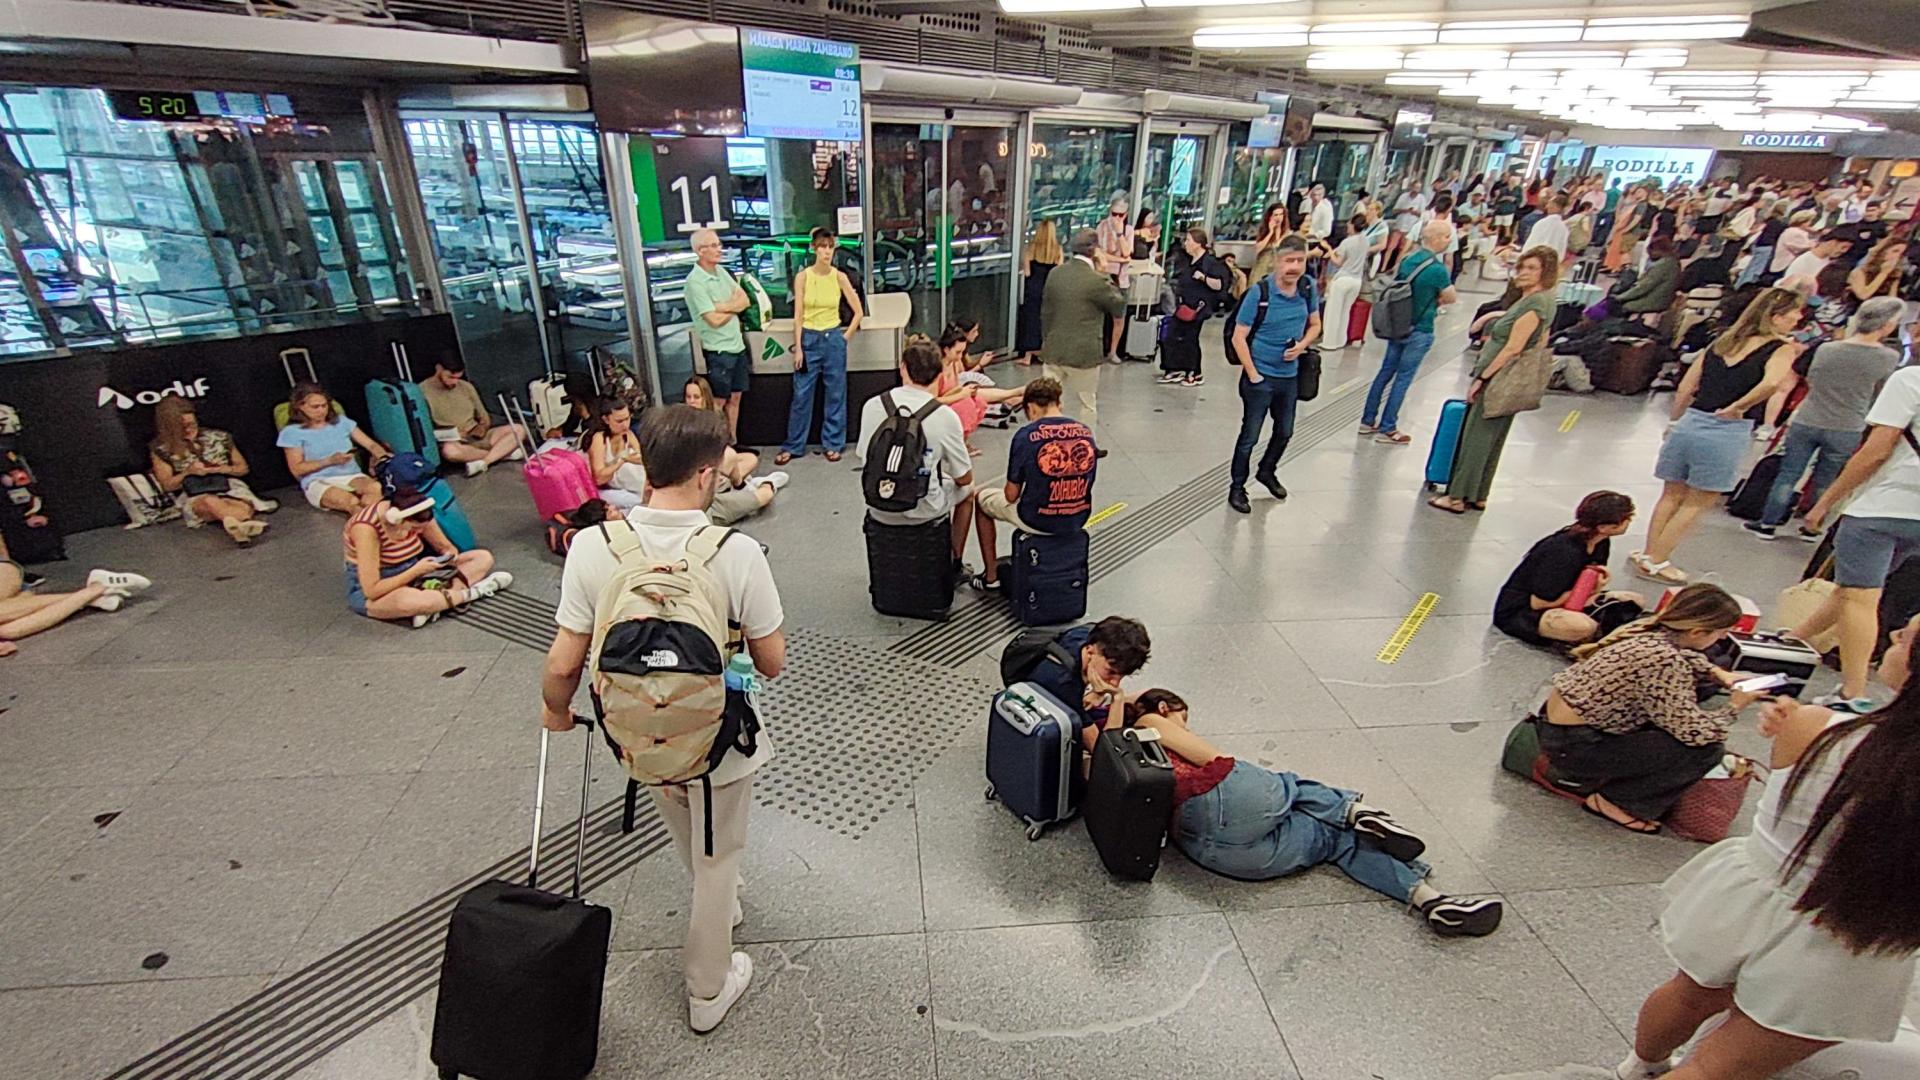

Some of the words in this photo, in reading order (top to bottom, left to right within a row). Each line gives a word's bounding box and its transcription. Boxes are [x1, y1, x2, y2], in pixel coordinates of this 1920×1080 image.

[812, 42, 853, 59] ZAMBRANO
[842, 98, 858, 117] 12
[1741, 134, 1826, 147] RODILLA
[1603, 159, 1694, 174] RODILLA
[1265, 166, 1282, 192] 12
[671, 175, 730, 232] 11
